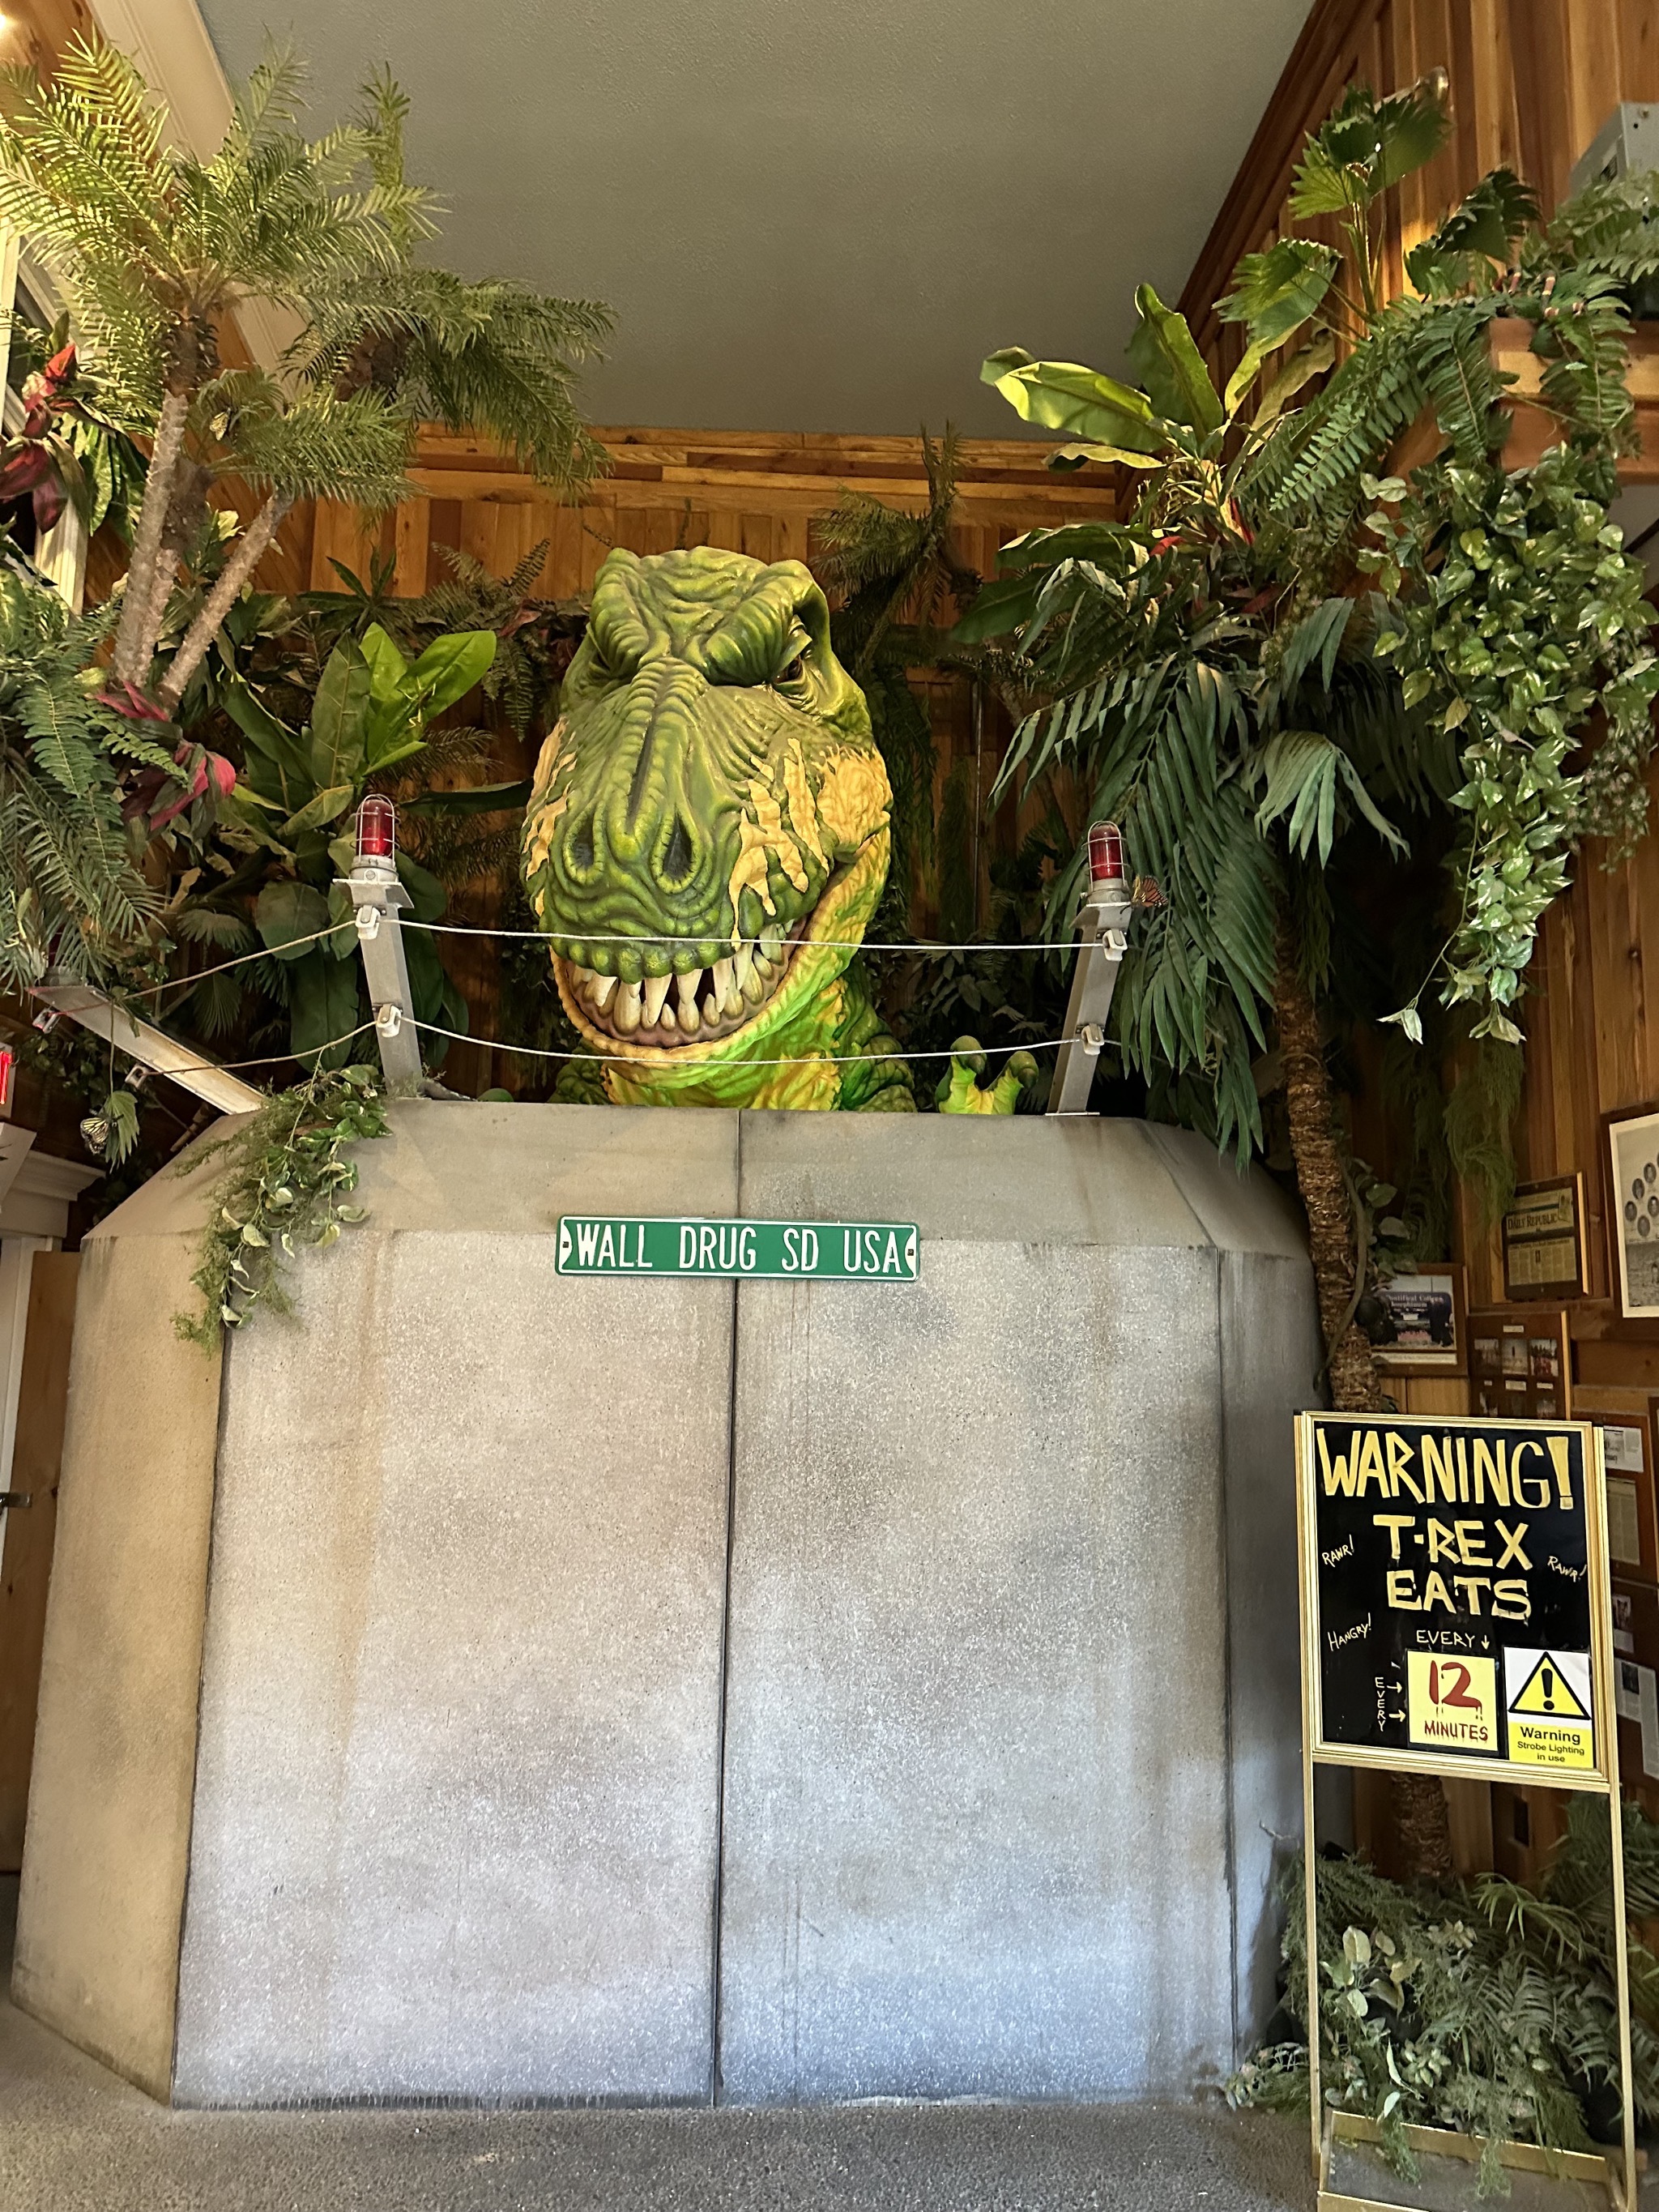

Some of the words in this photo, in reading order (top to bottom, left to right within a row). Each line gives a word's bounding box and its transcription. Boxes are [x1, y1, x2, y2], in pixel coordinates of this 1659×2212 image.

[1526, 1213, 1558, 1228] REPUBLIC
[576, 1223, 653, 1268] WALL
[679, 1225, 757, 1270] DRUG
[781, 1228, 819, 1271] SD
[843, 1229, 902, 1274] USA
[1316, 1428, 1575, 1510] WARNING!
[1321, 1534, 1355, 1568] RAWR!
[1547, 1556, 1588, 1583] RAWR!
[1386, 1569, 1532, 1623] EATS
[1327, 1612, 1372, 1652] HANGRY!
[1416, 1629, 1476, 1649] EVERY
[1429, 1659, 1482, 1710] 12
[1375, 1676, 1387, 1732] EVERY
[1424, 1719, 1488, 1742] MINUTES
[1520, 1726, 1580, 1745] Warning
[1517, 1740, 1546, 1751] Strobe
[1549, 1744, 1585, 1756] Lighting
[1537, 1753, 1546, 1761] in
[1548, 1754, 1566, 1762] use
